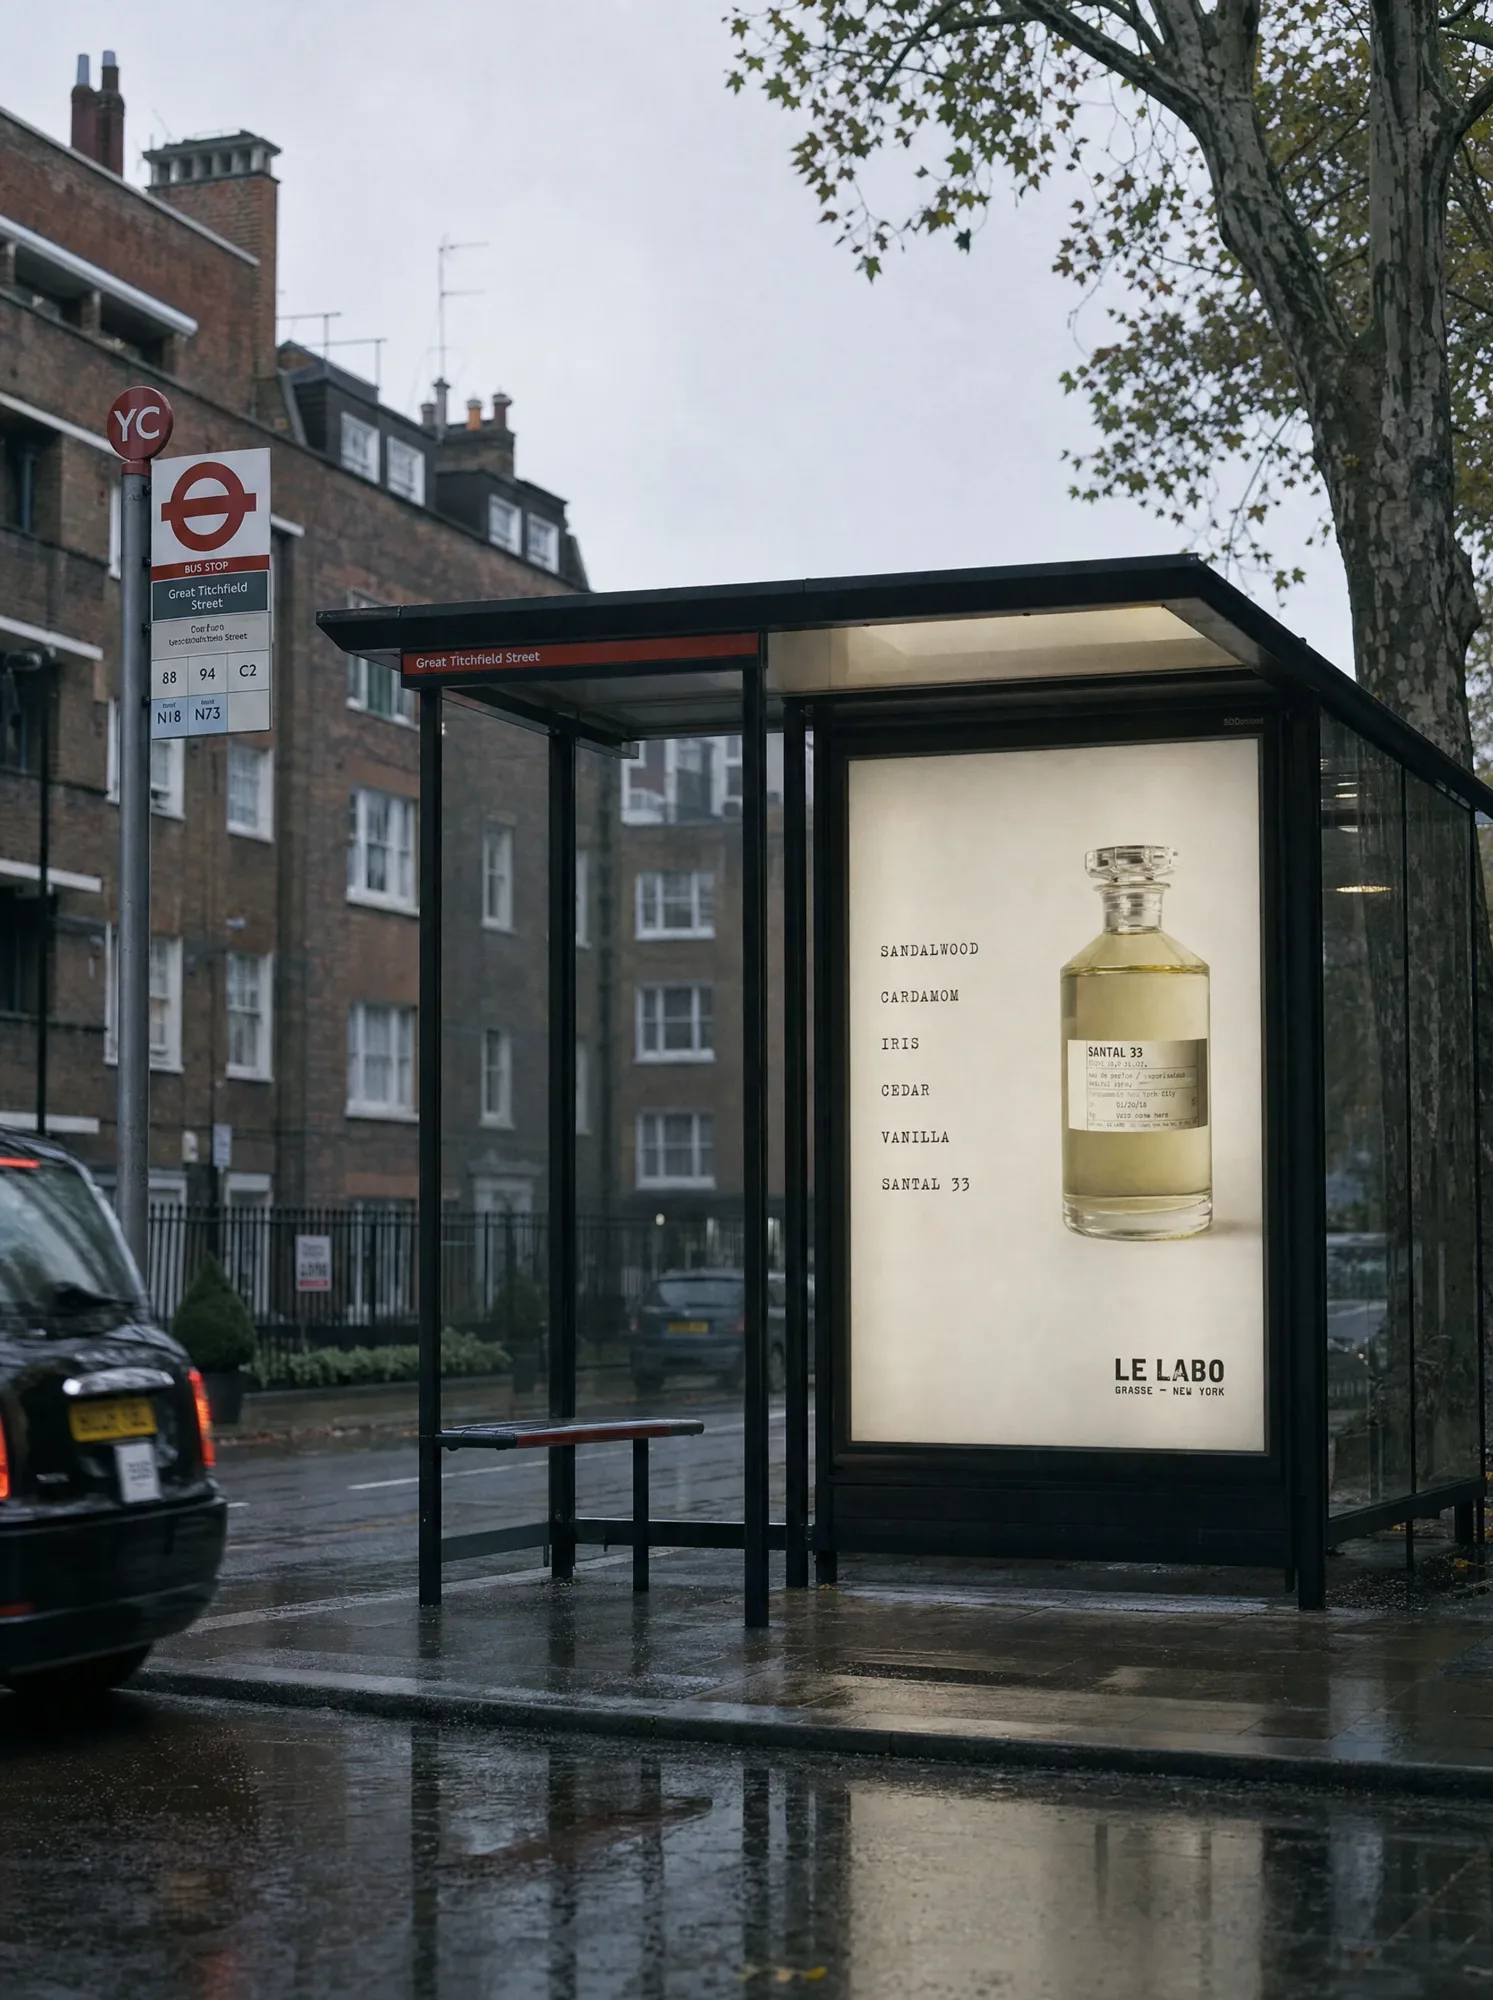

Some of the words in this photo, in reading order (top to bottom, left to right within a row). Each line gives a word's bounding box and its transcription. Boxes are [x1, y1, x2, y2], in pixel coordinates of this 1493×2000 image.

[113, 406, 160, 442] YC
[184, 563, 202, 574] BUS
[205, 561, 229, 572] STOP
[168, 587, 195, 599] Great
[198, 582, 248, 596] Titchfield
[191, 598, 223, 610] Street
[416, 657, 447, 668] Great
[450, 652, 502, 666] Titchfield
[505, 651, 541, 663] Street
[162, 671, 177, 684] 88
[200, 667, 216, 681] 94
[239, 664, 257, 677] C2
[157, 709, 181, 724] N18
[195, 706, 220, 720] N73
[880, 942, 979, 957] SANDALWOOD
[880, 989, 959, 1004] CARDAMOM
[881, 1037, 919, 1050] IRIS
[1088, 1046, 1126, 1058] SANTAL
[1130, 1047, 1143, 1058] 33
[881, 1084, 930, 1097] CEDAR
[881, 1131, 950, 1143] VANILLA
[882, 1178, 941, 1191] SANTAL
[951, 1177, 970, 1192] 33
[1115, 1358, 1147, 1381] LE
[1156, 1359, 1225, 1383] LABO
[1115, 1386, 1153, 1395] GRASSE
[1172, 1387, 1192, 1396] NEW
[1199, 1387, 1225, 1396] YORK
